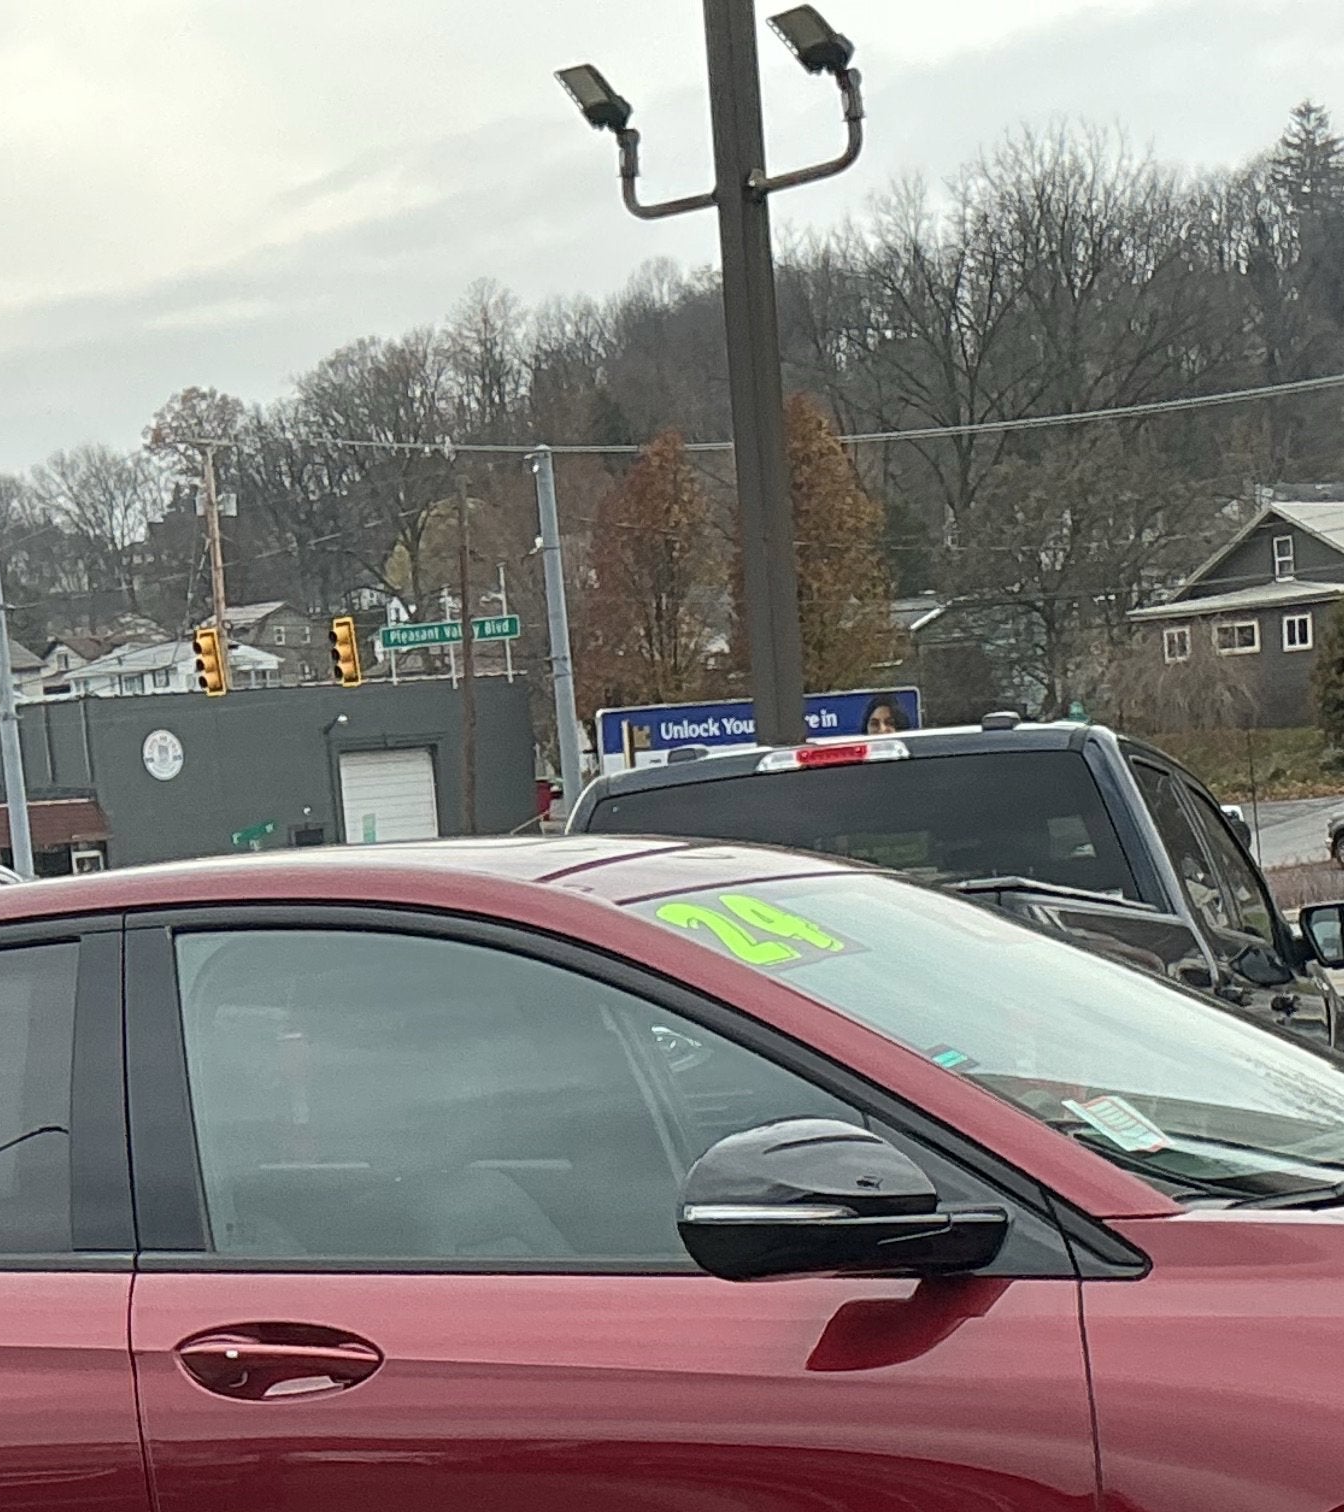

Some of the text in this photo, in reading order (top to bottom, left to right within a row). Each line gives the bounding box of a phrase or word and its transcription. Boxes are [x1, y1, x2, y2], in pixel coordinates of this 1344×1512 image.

[389, 619, 510, 644] Pleasant Valy Blvd
[660, 716, 721, 741] Unlock
[820, 708, 838, 728] in
[655, 894, 845, 966] 24
